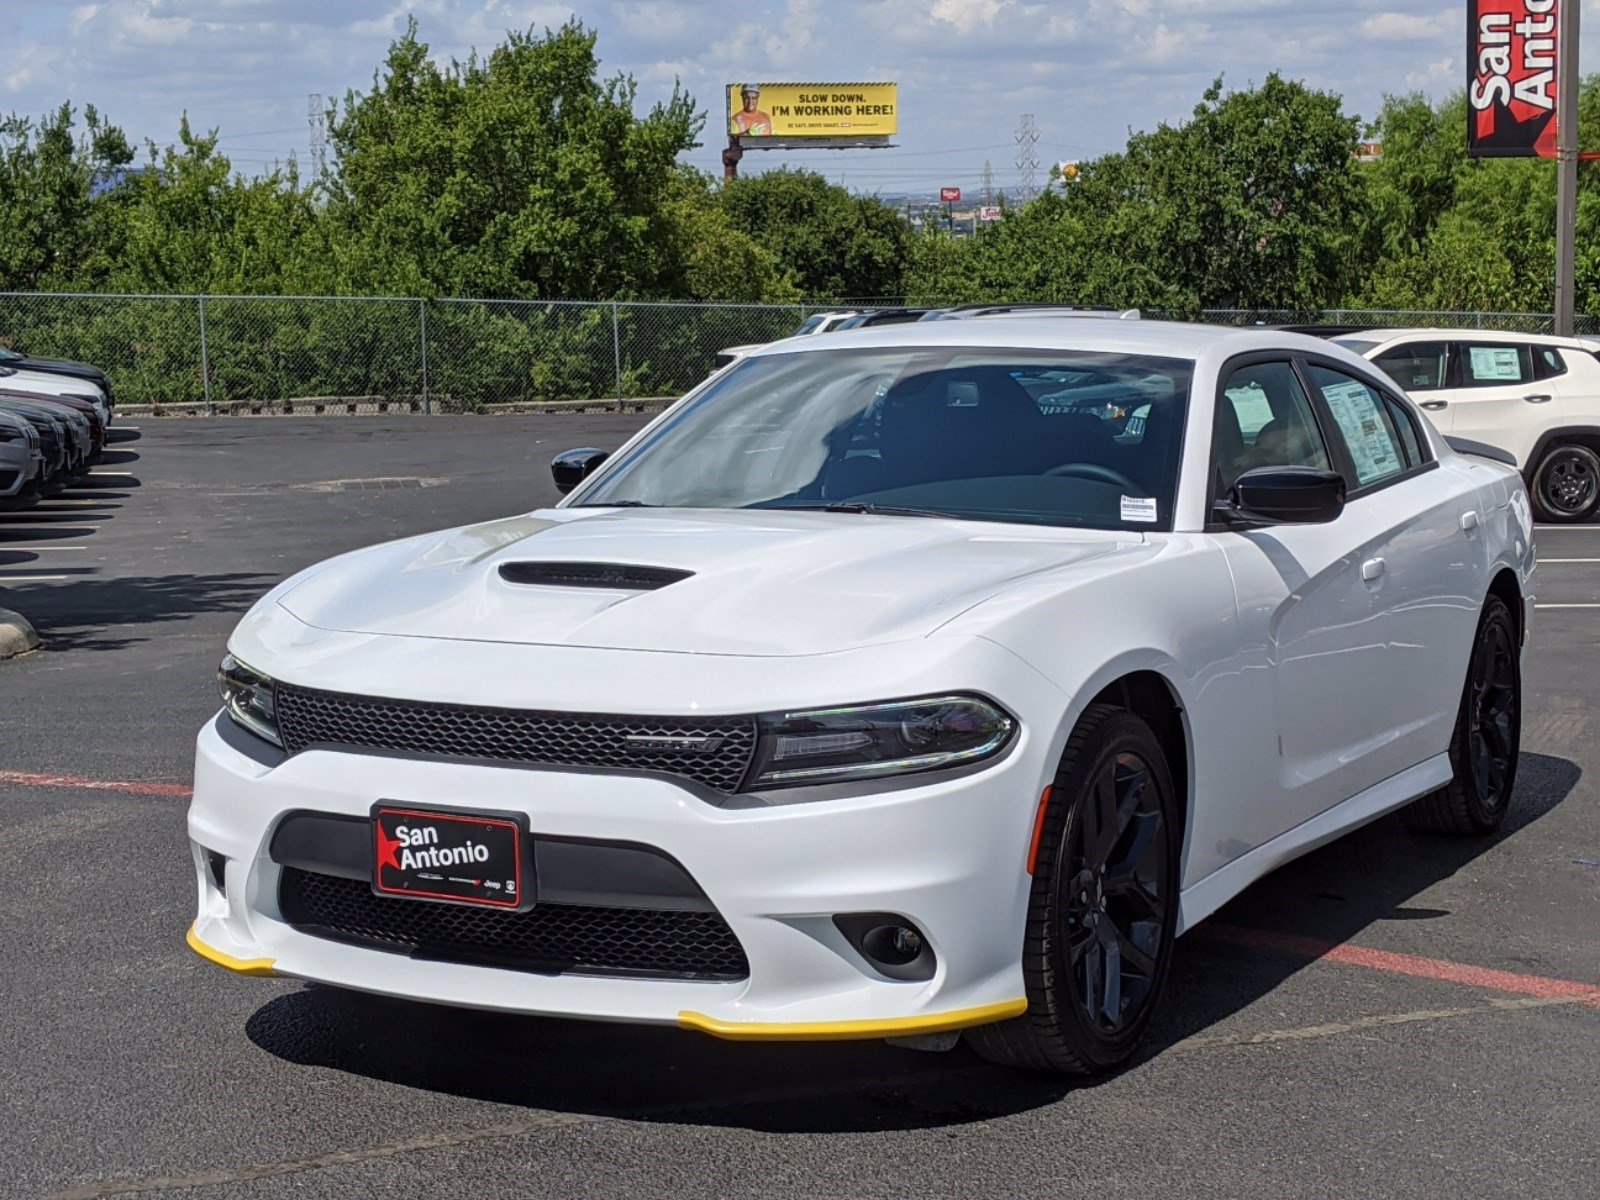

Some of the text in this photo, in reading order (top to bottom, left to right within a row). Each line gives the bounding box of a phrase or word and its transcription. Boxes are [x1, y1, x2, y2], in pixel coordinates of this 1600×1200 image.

[1470, 13, 1511, 110] San
[798, 94, 867, 103] SLOW DOWN.
[772, 104, 894, 116] I'M WORKING HERE!
[394, 825, 439, 848] San
[400, 840, 489, 871] Antonio
[483, 879, 501, 890] Jeep
